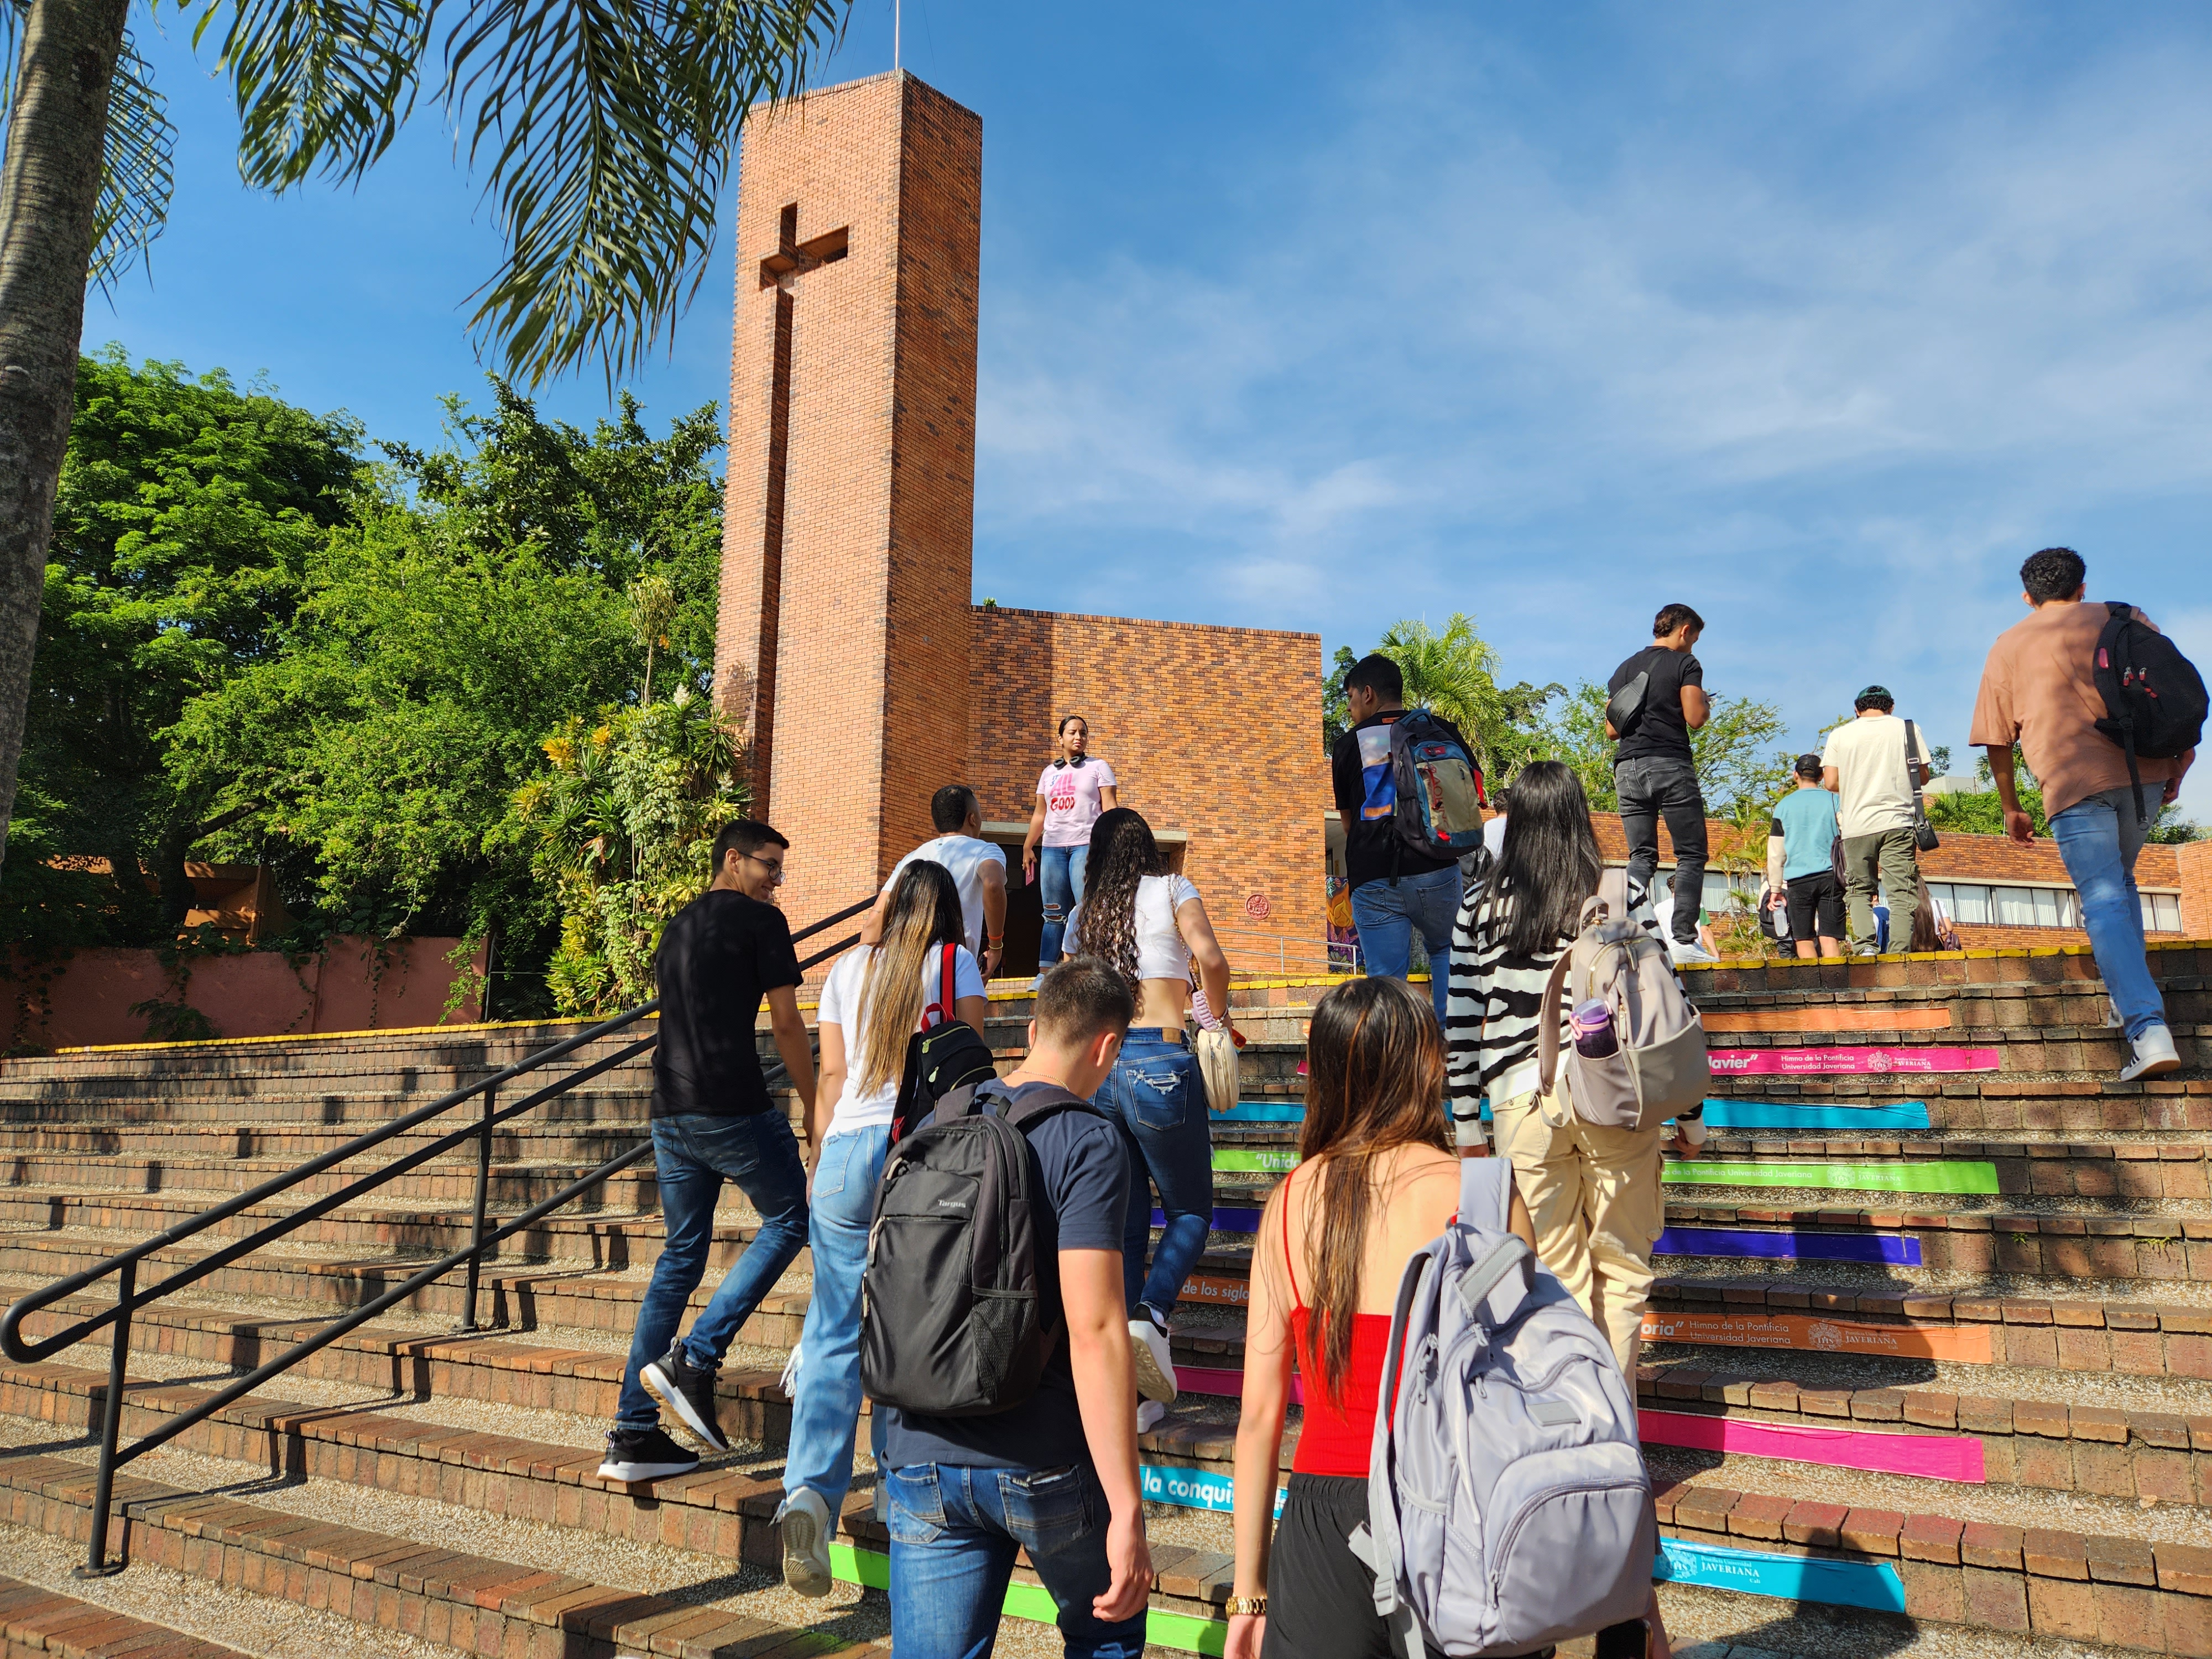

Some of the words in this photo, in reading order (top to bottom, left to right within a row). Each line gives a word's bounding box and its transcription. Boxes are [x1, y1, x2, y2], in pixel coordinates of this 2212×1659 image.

[1050, 796, 1075, 812] GOOD
[1775, 1170, 1812, 1178] Javeriana
[937, 1199, 966, 1208] Targus
[1182, 1280, 1197, 1294] de
[1201, 1281, 1218, 1296] los
[1689, 1321, 1719, 1329] Himno
[1721, 1321, 1733, 1330] de
[1736, 1322, 1744, 1331] la
[1747, 1322, 1789, 1332] Pontificia
[1690, 1332, 1744, 1342] Universidad
[1746, 1334, 1791, 1344] Javeriana
[1845, 1335, 1897, 1344] JAVERIANA
[1144, 1467, 1162, 1493] la
[1168, 1480, 1234, 1509] conqui
[1700, 1555, 1723, 1564] Pontificia
[1724, 1558, 1752, 1567] Universidad
[1701, 1562, 1760, 1577] JAVERIANA
